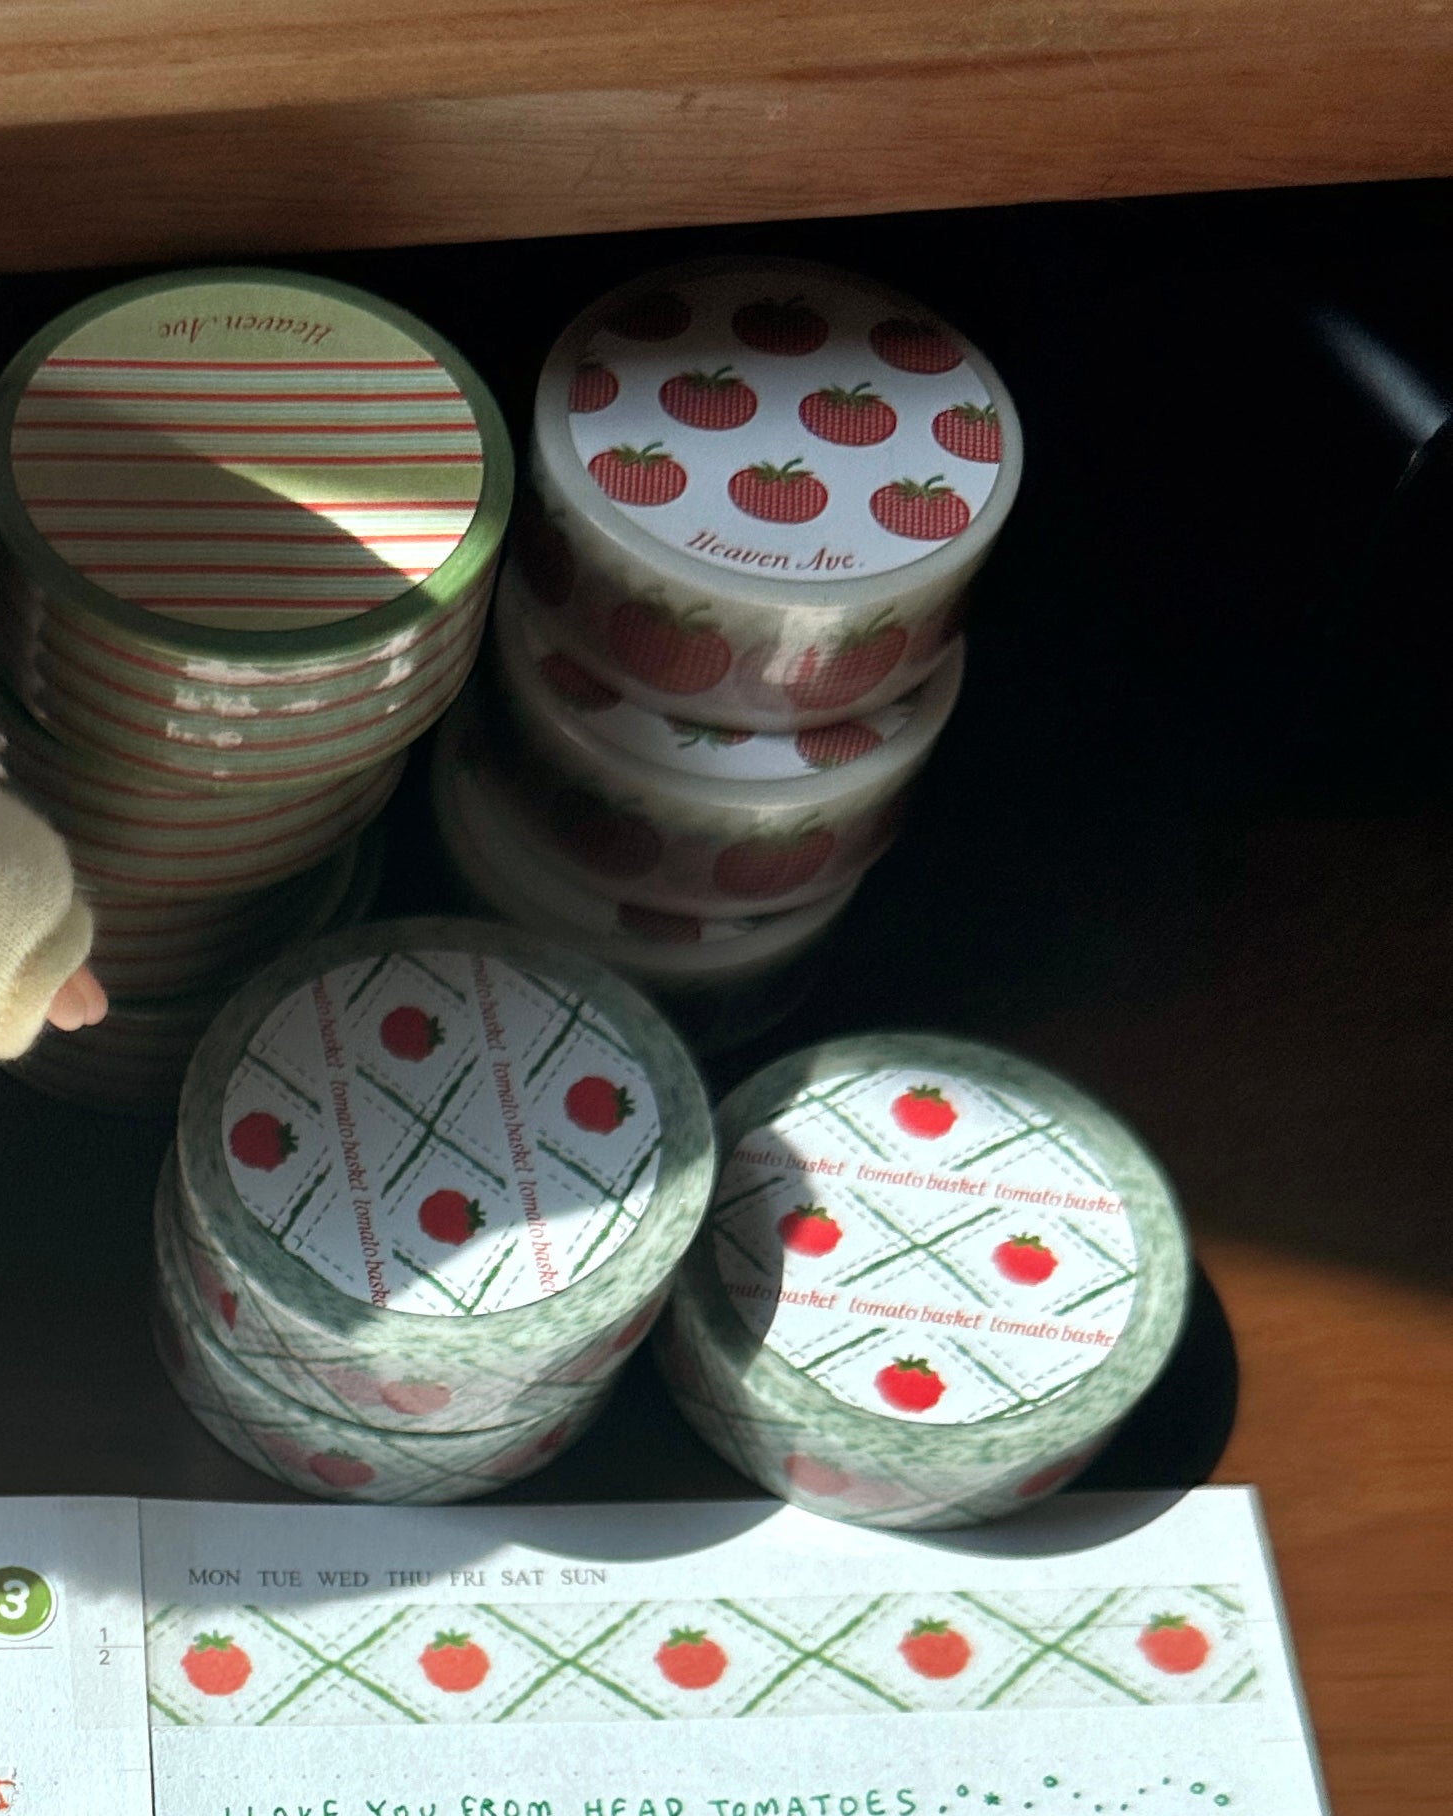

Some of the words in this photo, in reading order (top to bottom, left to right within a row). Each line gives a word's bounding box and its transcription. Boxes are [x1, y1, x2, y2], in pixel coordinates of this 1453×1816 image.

[226, 312, 334, 344] Heaven
[685, 528, 789, 570] Heaven
[856, 1164, 925, 1188] tomato
[925, 1172, 988, 1197] basket
[995, 1183, 1062, 1204] tomato
[848, 1298, 918, 1321] tomato
[920, 1306, 983, 1330] basket
[989, 1319, 1059, 1340] tomato
[188, 1568, 241, 1586] MON
[258, 1570, 301, 1587] TUE
[318, 1570, 369, 1587] WED
[385, 1569, 432, 1587] THU
[451, 1569, 486, 1587] FRI
[501, 1568, 545, 1586] SAT
[561, 1567, 608, 1586] SUN
[99, 1627, 108, 1642] 1
[99, 1650, 110, 1666] 2
